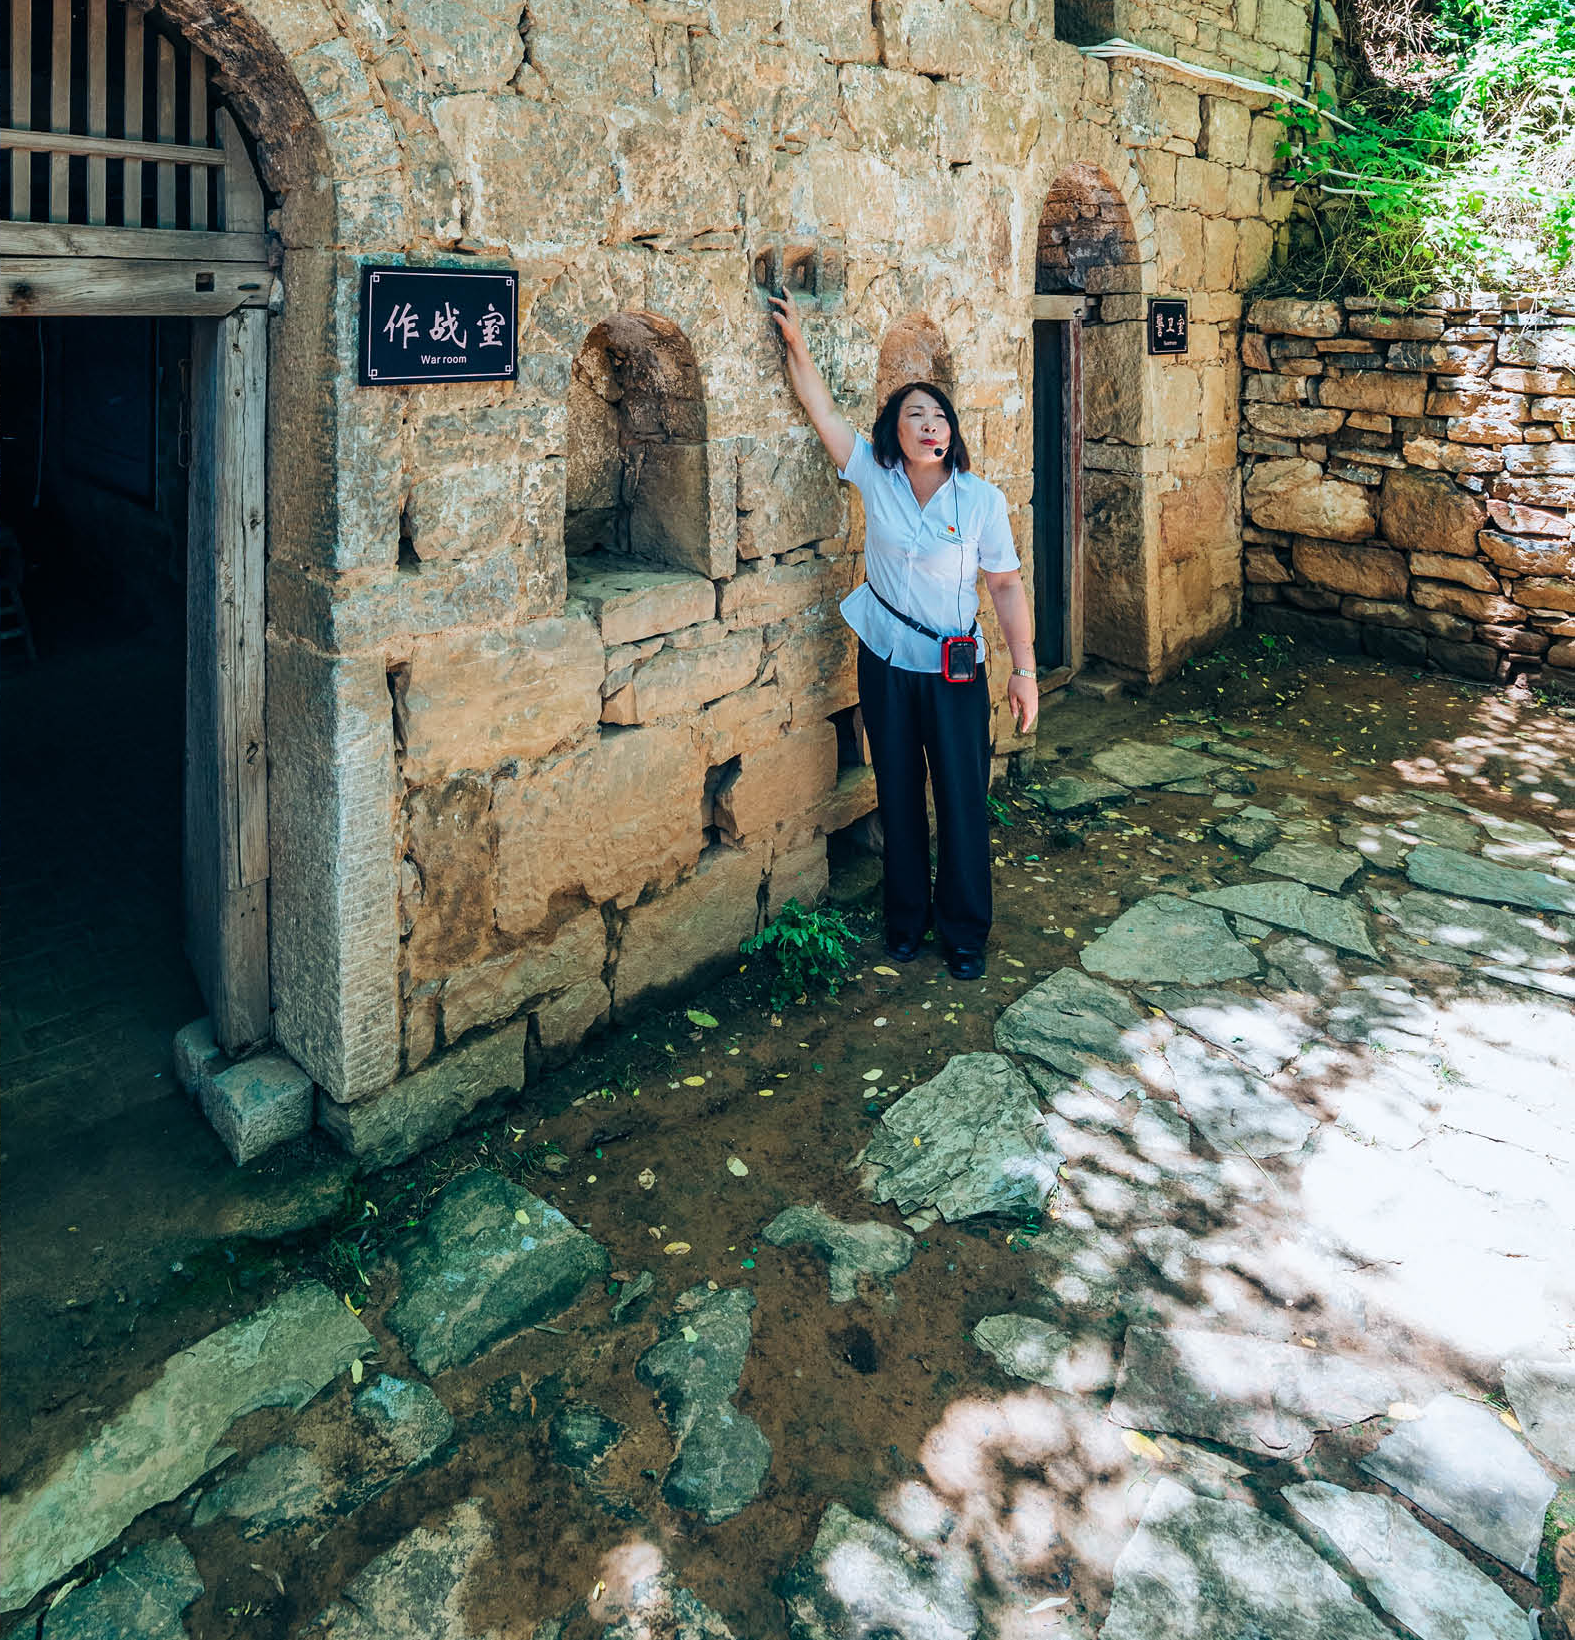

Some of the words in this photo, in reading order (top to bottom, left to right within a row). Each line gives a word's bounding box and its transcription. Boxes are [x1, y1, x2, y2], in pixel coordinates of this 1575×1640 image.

[382, 301, 506, 350] 作战室
[420, 354, 441, 365] War
[442, 355, 467, 364] room
